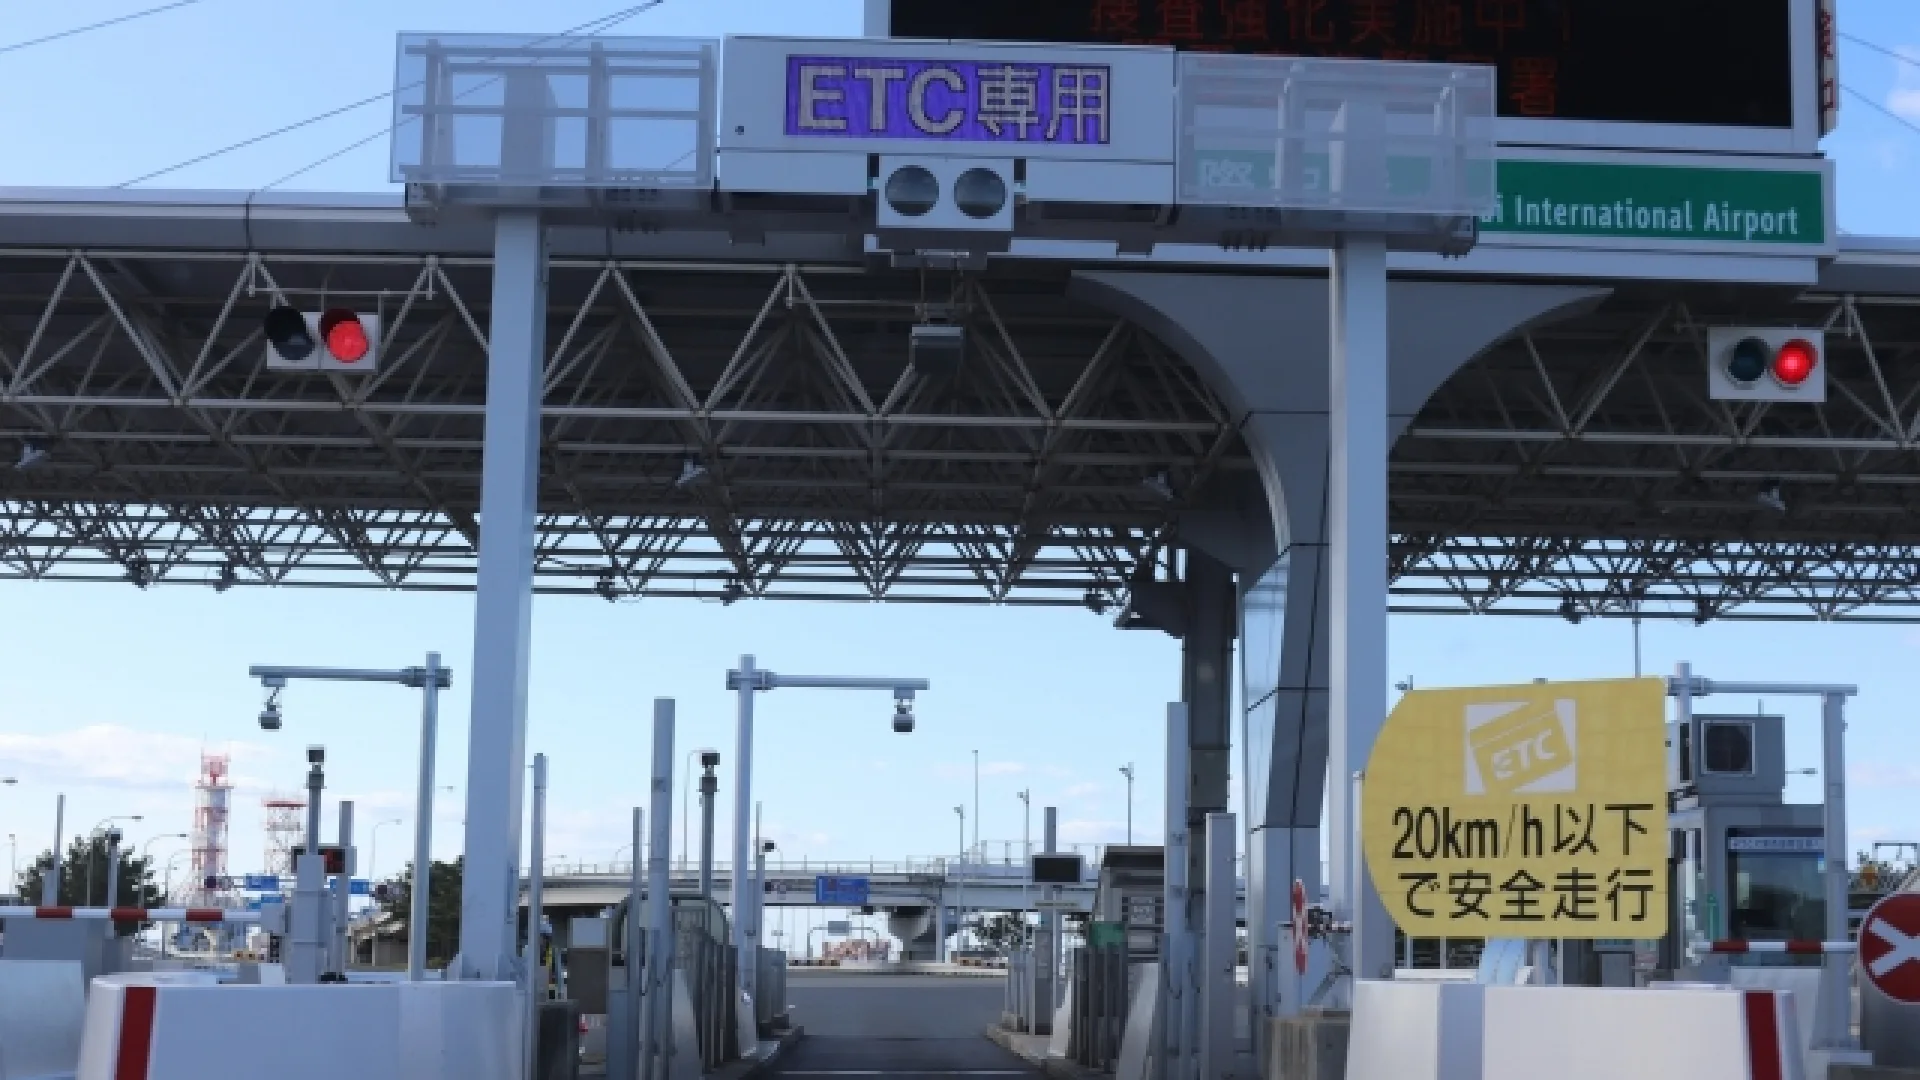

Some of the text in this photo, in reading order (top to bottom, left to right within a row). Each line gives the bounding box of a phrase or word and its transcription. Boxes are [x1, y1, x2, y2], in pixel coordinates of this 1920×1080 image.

[799, 64, 1109, 142] ETC専用
[1514, 193, 1693, 233] International
[1703, 200, 1798, 241] Airport
[1490, 727, 1557, 780] ETC
[1391, 803, 1655, 860] 20km/h以下
[1397, 866, 1655, 922] で安全走行
